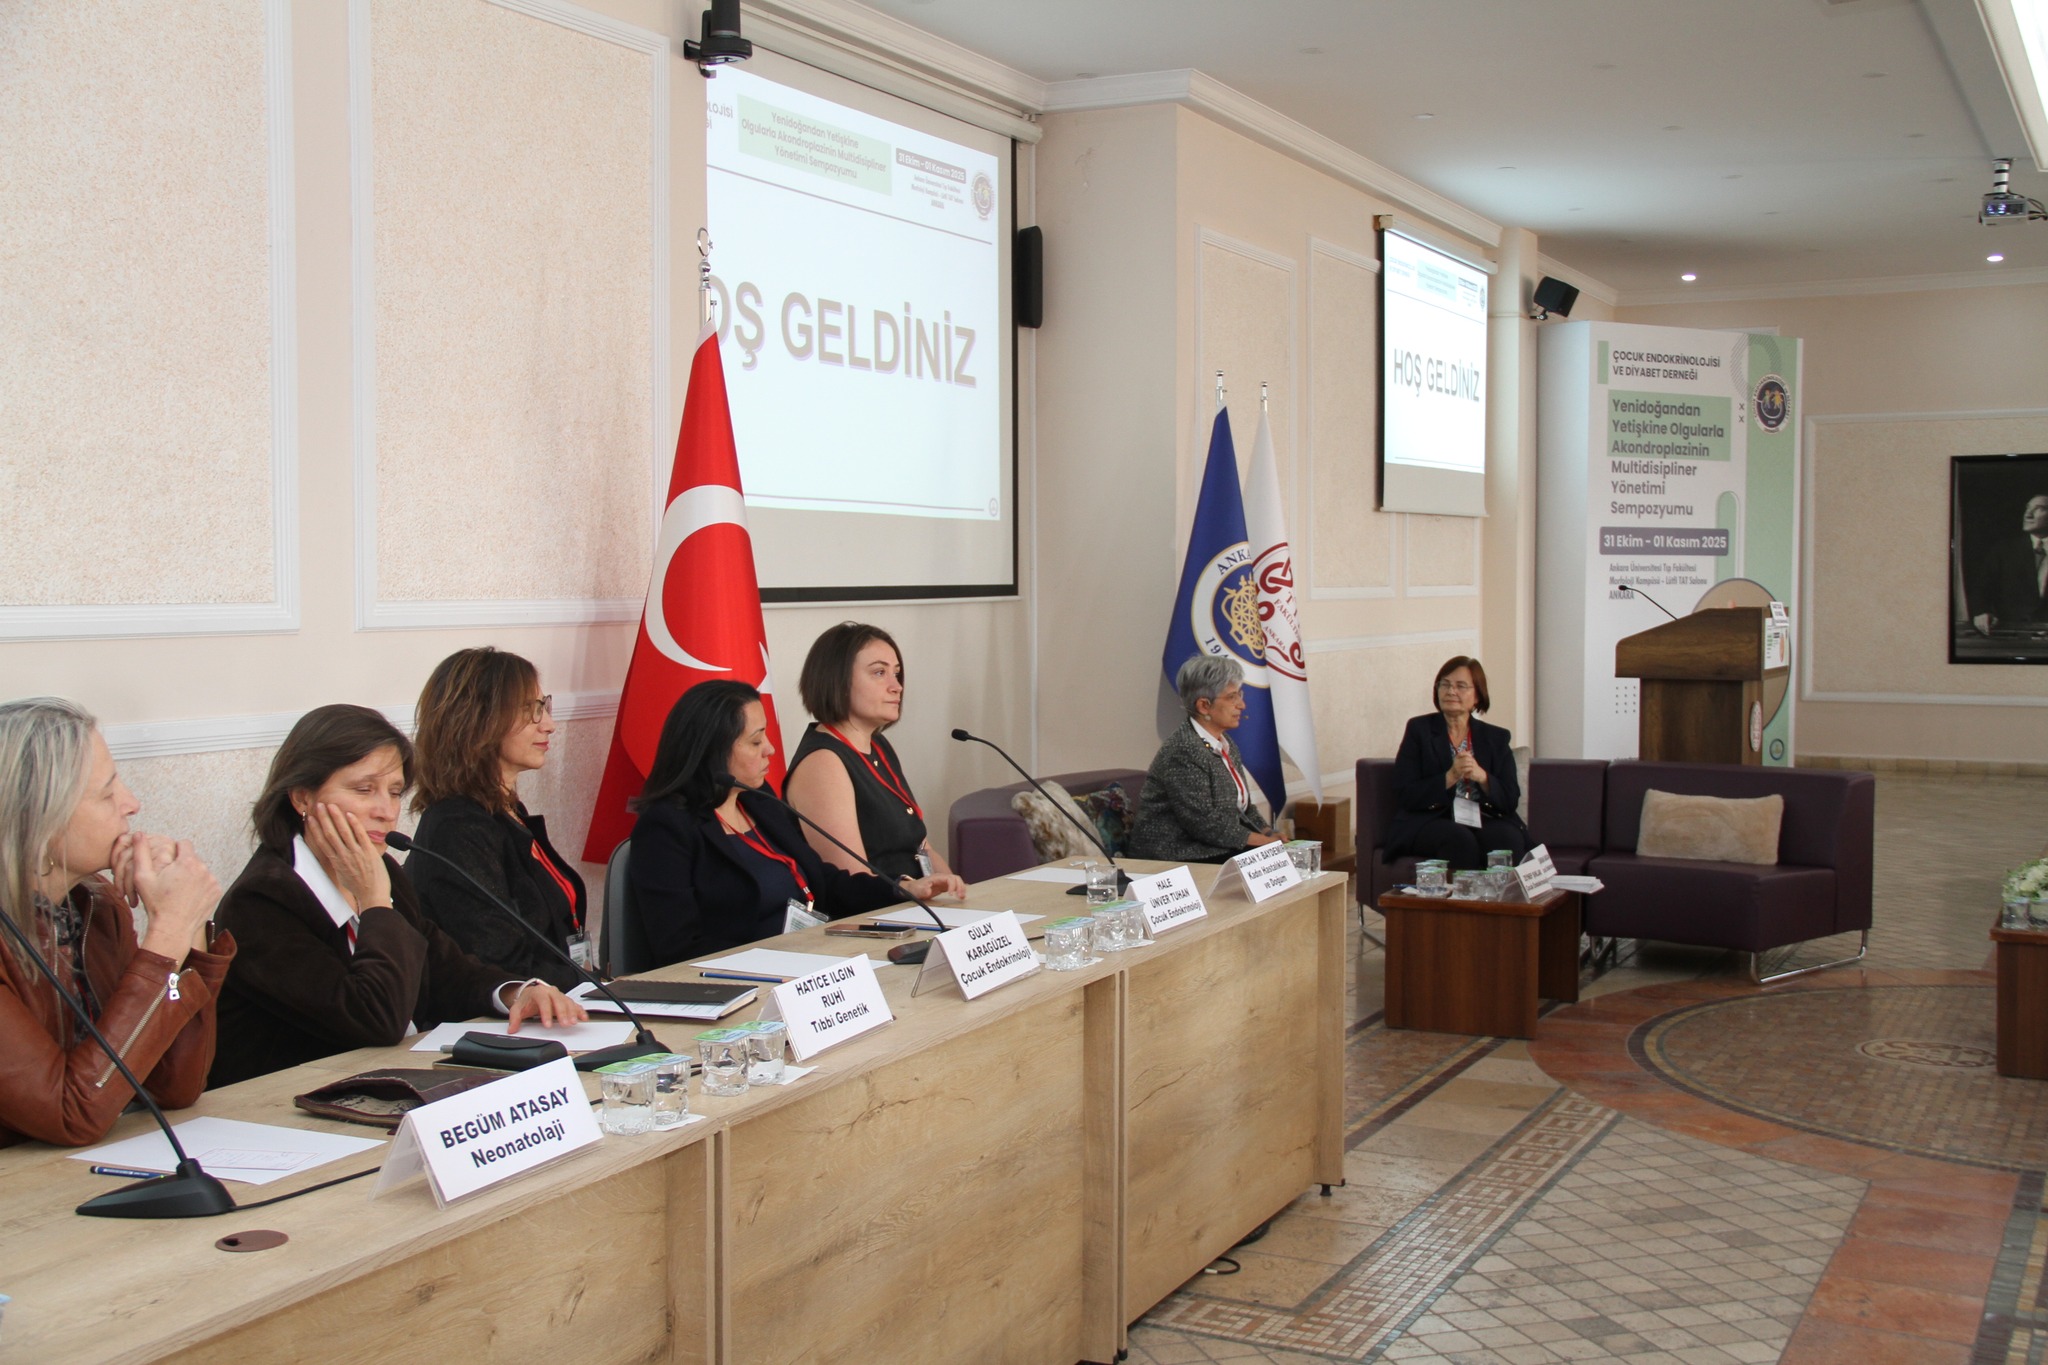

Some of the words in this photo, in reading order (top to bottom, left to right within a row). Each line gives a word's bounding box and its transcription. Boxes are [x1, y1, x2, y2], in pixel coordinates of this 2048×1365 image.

[771, 112, 826, 139] Yenidoğandan
[827, 130, 860, 149] Yetişkine
[741, 118, 777, 139] Olgularla
[778, 131, 837, 157] Akondroplazinin
[837, 149, 887, 173] Multidisipliner
[775, 145, 809, 164] Yönetimi
[809, 156, 858, 179] Sempozyumu
[781, 291, 977, 389] GELDİNİZ
[1613, 350, 1645, 363] ÇOCUK
[1646, 352, 1721, 368] ENDOKRİNOLOJİSİ
[1394, 348, 1422, 398] HOŞ
[1426, 356, 1480, 402] GELDİNİZ
[1613, 366, 1624, 377] VE
[1625, 365, 1661, 379] DİYABET
[1662, 367, 1698, 381] DERNEĞİ
[1612, 399, 1701, 418] Yenidoğandan
[1612, 420, 1668, 438] Yetişkine
[1670, 423, 1724, 441] Olgularla
[1611, 440, 1710, 459] Akondroplazinin
[1611, 460, 1698, 479] Multidisipliner
[1611, 480, 1666, 496] Yönetimi
[1610, 501, 1693, 519] Sempozyumu
[1604, 534, 1615, 547] 31
[1616, 534, 1643, 548] Ekim
[1653, 536, 1664, 548] 01
[1666, 535, 1700, 548] Kasım
[1702, 536, 1727, 549] 2025
[1609, 563, 1629, 572] Ankara
[1609, 590, 1635, 600] ANKARA
[1263, 625, 1286, 651] ANKARA
[1156, 878, 1173, 890] HALE
[1149, 894, 1171, 909] ÜNVER
[1170, 888, 1190, 902] TUHAN
[1150, 911, 1170, 927] Çocuk
[1167, 899, 1202, 919] Endokrinoloji
[968, 921, 994, 941] GÜLAY
[965, 934, 1012, 962] KARAGÜZEL
[960, 967, 986, 987] Çocuk
[986, 948, 1032, 978] Endokrinoloji
[795, 973, 829, 996] HATİCE
[830, 965, 856, 986] ILGIN
[821, 989, 846, 1009] RUHİ
[811, 1014, 835, 1034] Tıbbi
[836, 1002, 870, 1025] Genetik
[440, 1112, 506, 1149] BEGÜM
[510, 1086, 571, 1124] ATASAY
[471, 1119, 566, 1168] Neonatolaji
